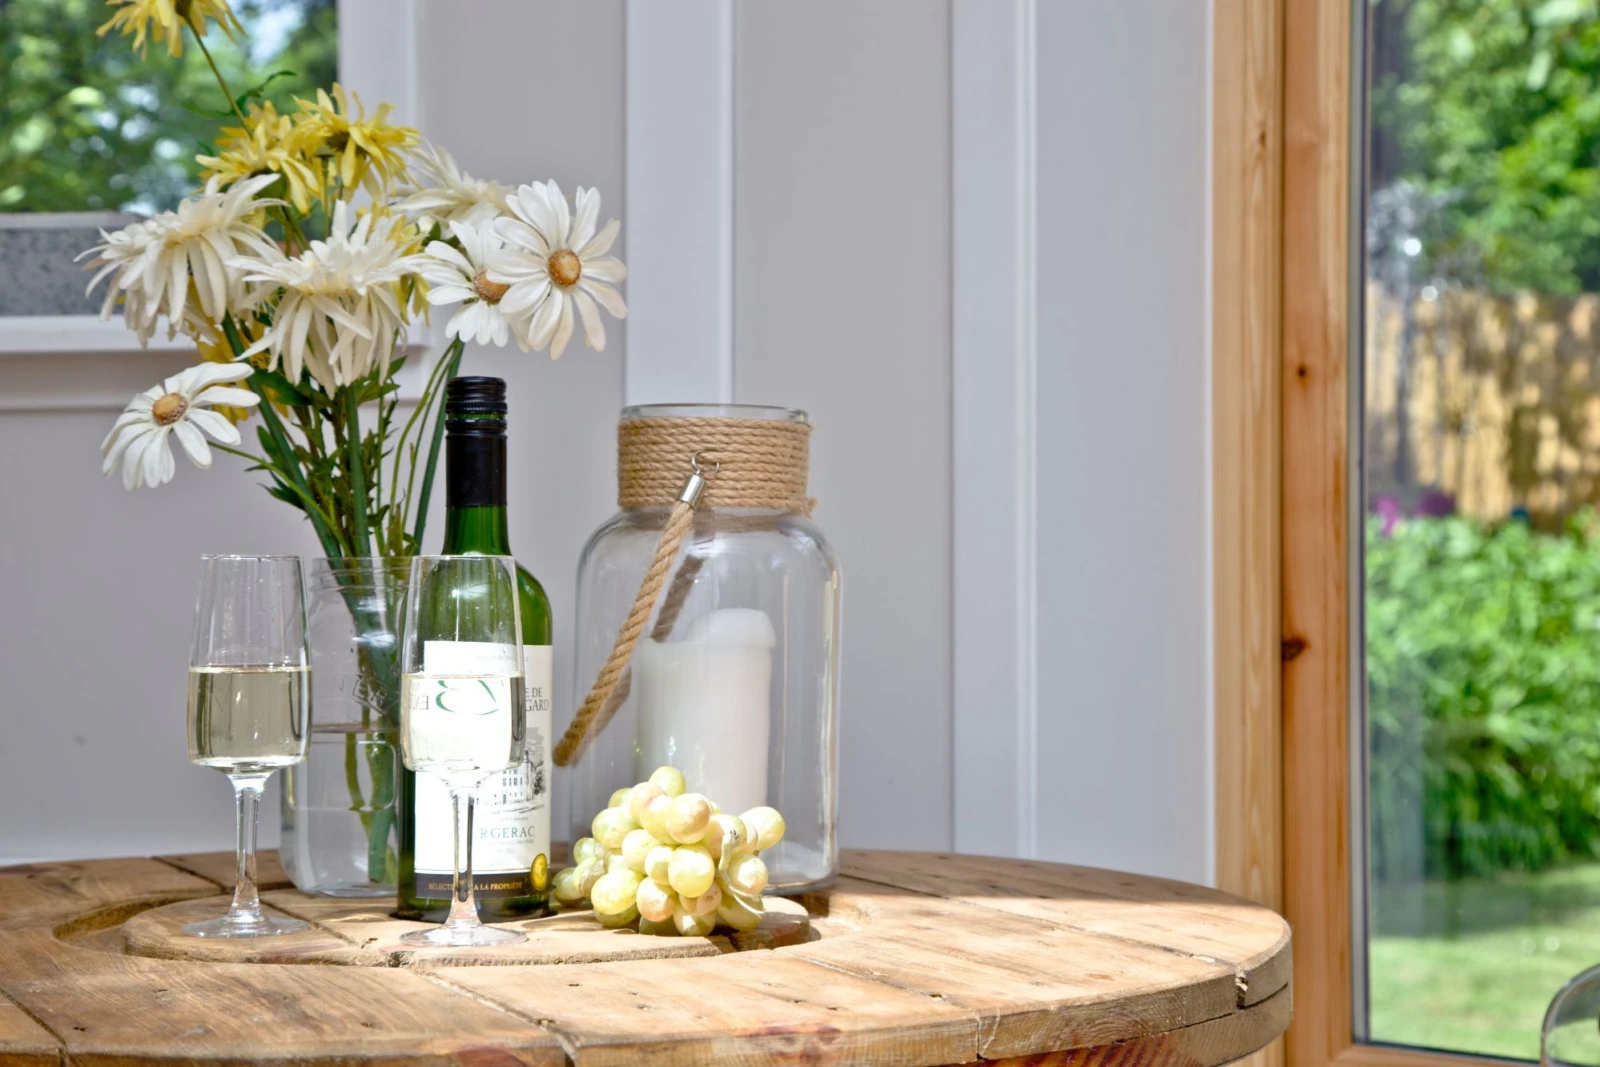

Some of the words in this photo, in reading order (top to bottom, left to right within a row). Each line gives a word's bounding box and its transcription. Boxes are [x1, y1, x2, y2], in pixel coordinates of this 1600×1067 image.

[532, 687, 543, 698] DE
[525, 699, 549, 711] GARD
[480, 825, 535, 839] RGERAC
[480, 882, 489, 890] LA
